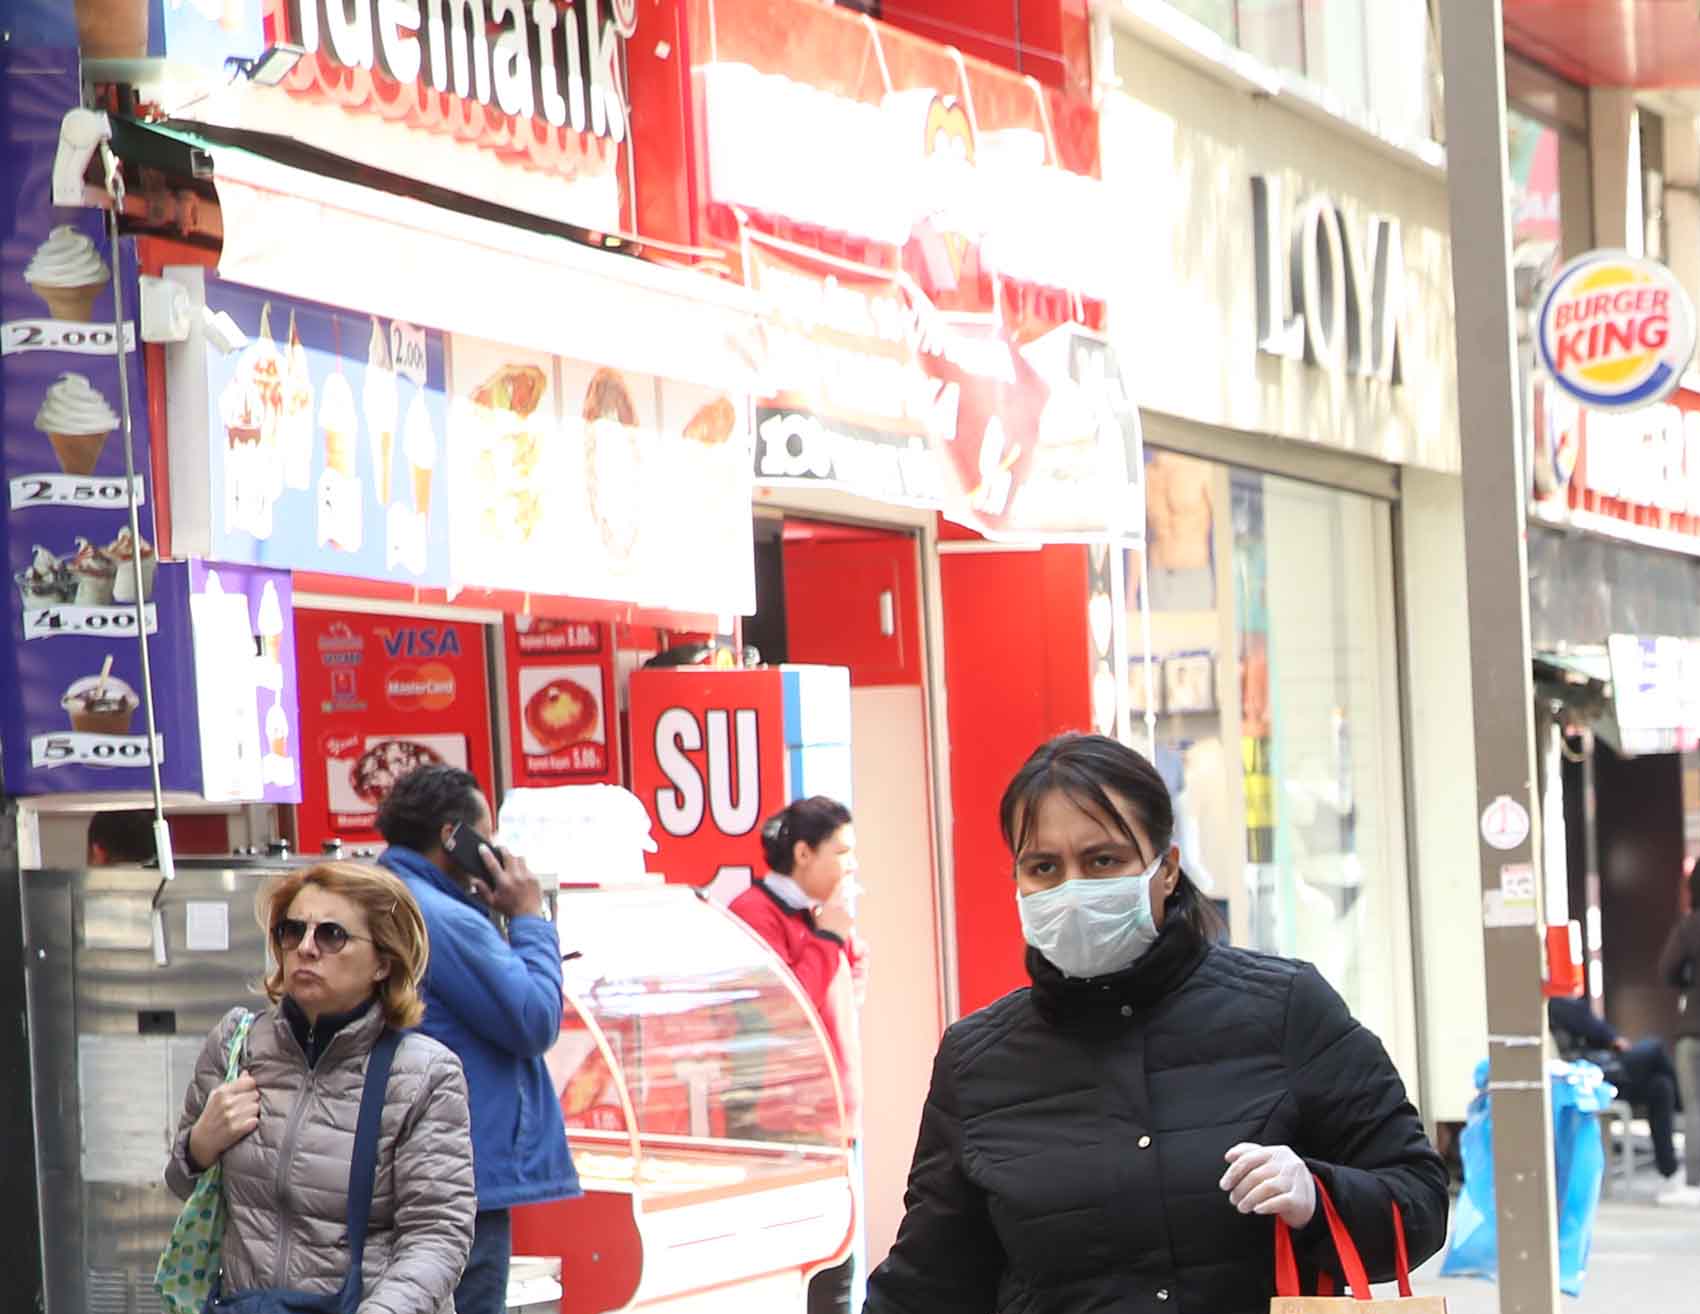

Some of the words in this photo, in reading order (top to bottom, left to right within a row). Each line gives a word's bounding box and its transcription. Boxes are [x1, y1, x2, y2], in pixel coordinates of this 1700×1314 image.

[1555, 288, 1670, 330] BURGER
[1554, 315, 1668, 374] KING
[383, 627, 461, 657] VISA
[654, 706, 761, 837] SU
